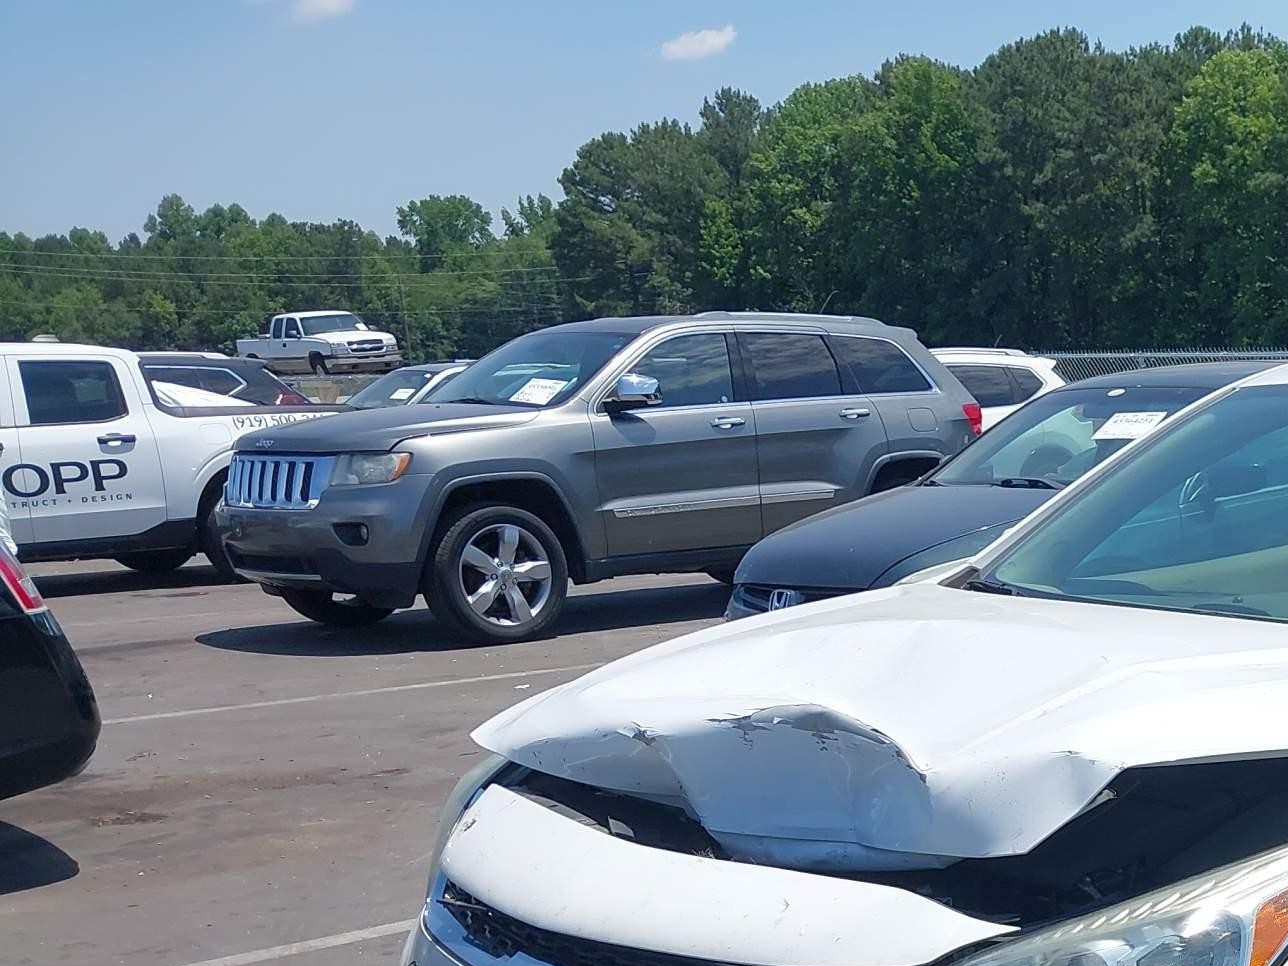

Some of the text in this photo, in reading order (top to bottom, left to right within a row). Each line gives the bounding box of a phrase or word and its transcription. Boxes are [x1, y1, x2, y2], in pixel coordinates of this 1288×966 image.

[232, 415, 268, 430] (919)
[2, 458, 128, 498] OPP
[82, 493, 133, 503] DESIGN
